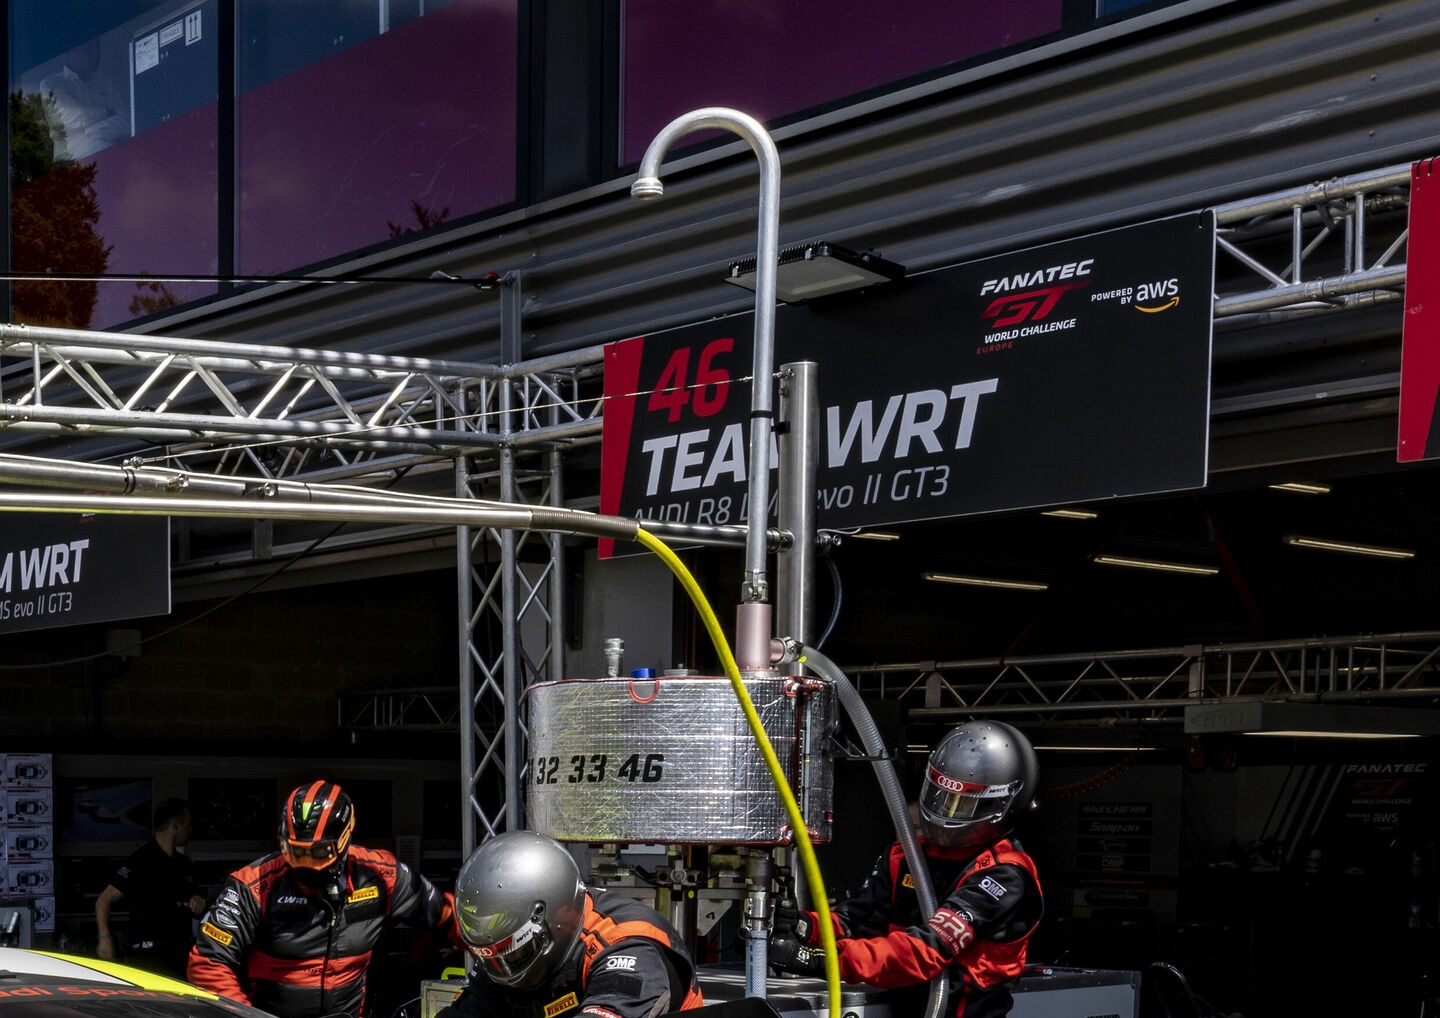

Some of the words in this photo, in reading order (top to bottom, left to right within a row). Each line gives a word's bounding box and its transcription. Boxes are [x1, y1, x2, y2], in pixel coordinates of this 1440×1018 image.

[980, 259, 1095, 296] FANATEC
[1136, 278, 1179, 302] aws
[1091, 288, 1133, 302] POWERED
[1120, 296, 1132, 305] BY
[985, 329, 1019, 344] WORLD
[1020, 319, 1077, 337] CHALLENGE
[977, 342, 1013, 355] EUROPE
[647, 337, 735, 423] 46
[641, 421, 781, 497] TEA
[826, 378, 999, 469] WRT
[697, 496, 732, 525] R8
[817, 485, 854, 511] vo
[864, 473, 881, 505] II
[891, 465, 951, 501] GT3
[19, 538, 89, 591] WRT
[13, 601, 33, 617] evo
[37, 600, 45, 615] II
[48, 591, 72, 613] GT3
[536, 756, 560, 784] 32
[568, 754, 607, 783] 33
[618, 753, 664, 784] 46
[981, 878, 1004, 898] OMP
[607, 956, 637, 970] OMP
[57, 986, 186, 1001] Sport
[547, 993, 578, 1018] PIRELLI
